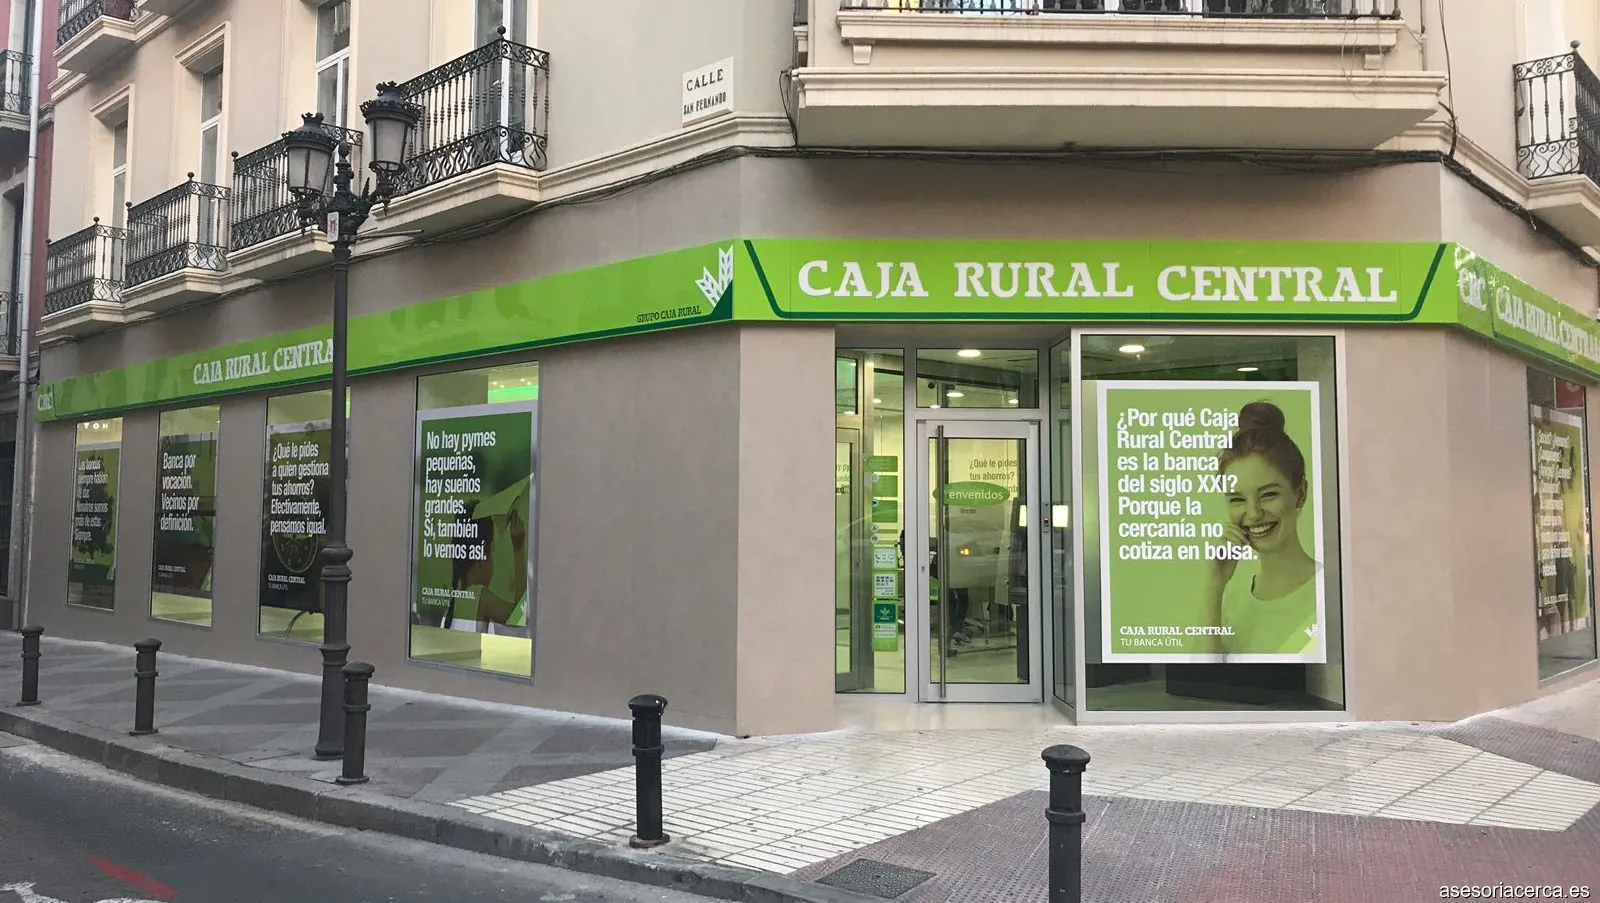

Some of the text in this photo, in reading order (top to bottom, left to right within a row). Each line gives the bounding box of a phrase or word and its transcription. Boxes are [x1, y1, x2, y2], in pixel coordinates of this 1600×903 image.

[686, 68, 723, 91] CALLE
[683, 91, 726, 115] SAN FERNANDO
[798, 260, 1398, 303] CAJA RURAL CENTRAL
[637, 305, 702, 323] GRUPO CAJA RURAL
[193, 338, 334, 385] CAJA RURAL CENTRA
[1117, 407, 1239, 433] ¿Por qué Caja
[426, 430, 496, 452] No hay pymes
[1117, 430, 1233, 449] Rural Central
[272, 441, 319, 462] ¿Qué le pides
[1117, 453, 1219, 471] es la banca
[163, 452, 196, 474] Banca por
[272, 460, 329, 481] a quien gestiona
[425, 451, 476, 475] pequeñas,
[969, 458, 1018, 470] ¿Qué le pides
[162, 471, 192, 490] vocación.
[425, 473, 480, 497] hay sueños
[970, 471, 1015, 480] tus ahorros?
[1117, 475, 1238, 497] del siglo XXI?
[271, 480, 315, 496] tus ahorros?
[946, 488, 1003, 500] envenidos
[161, 492, 199, 514] Vecinos por
[271, 498, 321, 517] Efectivamente,
[424, 497, 467, 518] grandes.
[1118, 497, 1202, 519] Porque la
[160, 512, 194, 532] definición.
[270, 517, 326, 537] pensamos igual.
[424, 518, 478, 540] Sí, también
[1119, 519, 1224, 538] cercanía no
[423, 539, 487, 560] lo vemos así.
[1119, 541, 1258, 560] cotiza en bolsa.
[451, 590, 476, 600] CENTRAL
[1119, 626, 1236, 636] CAJA RURAL CENTRAL
[1120, 636, 1184, 646] TU BANCA ÚTIL
